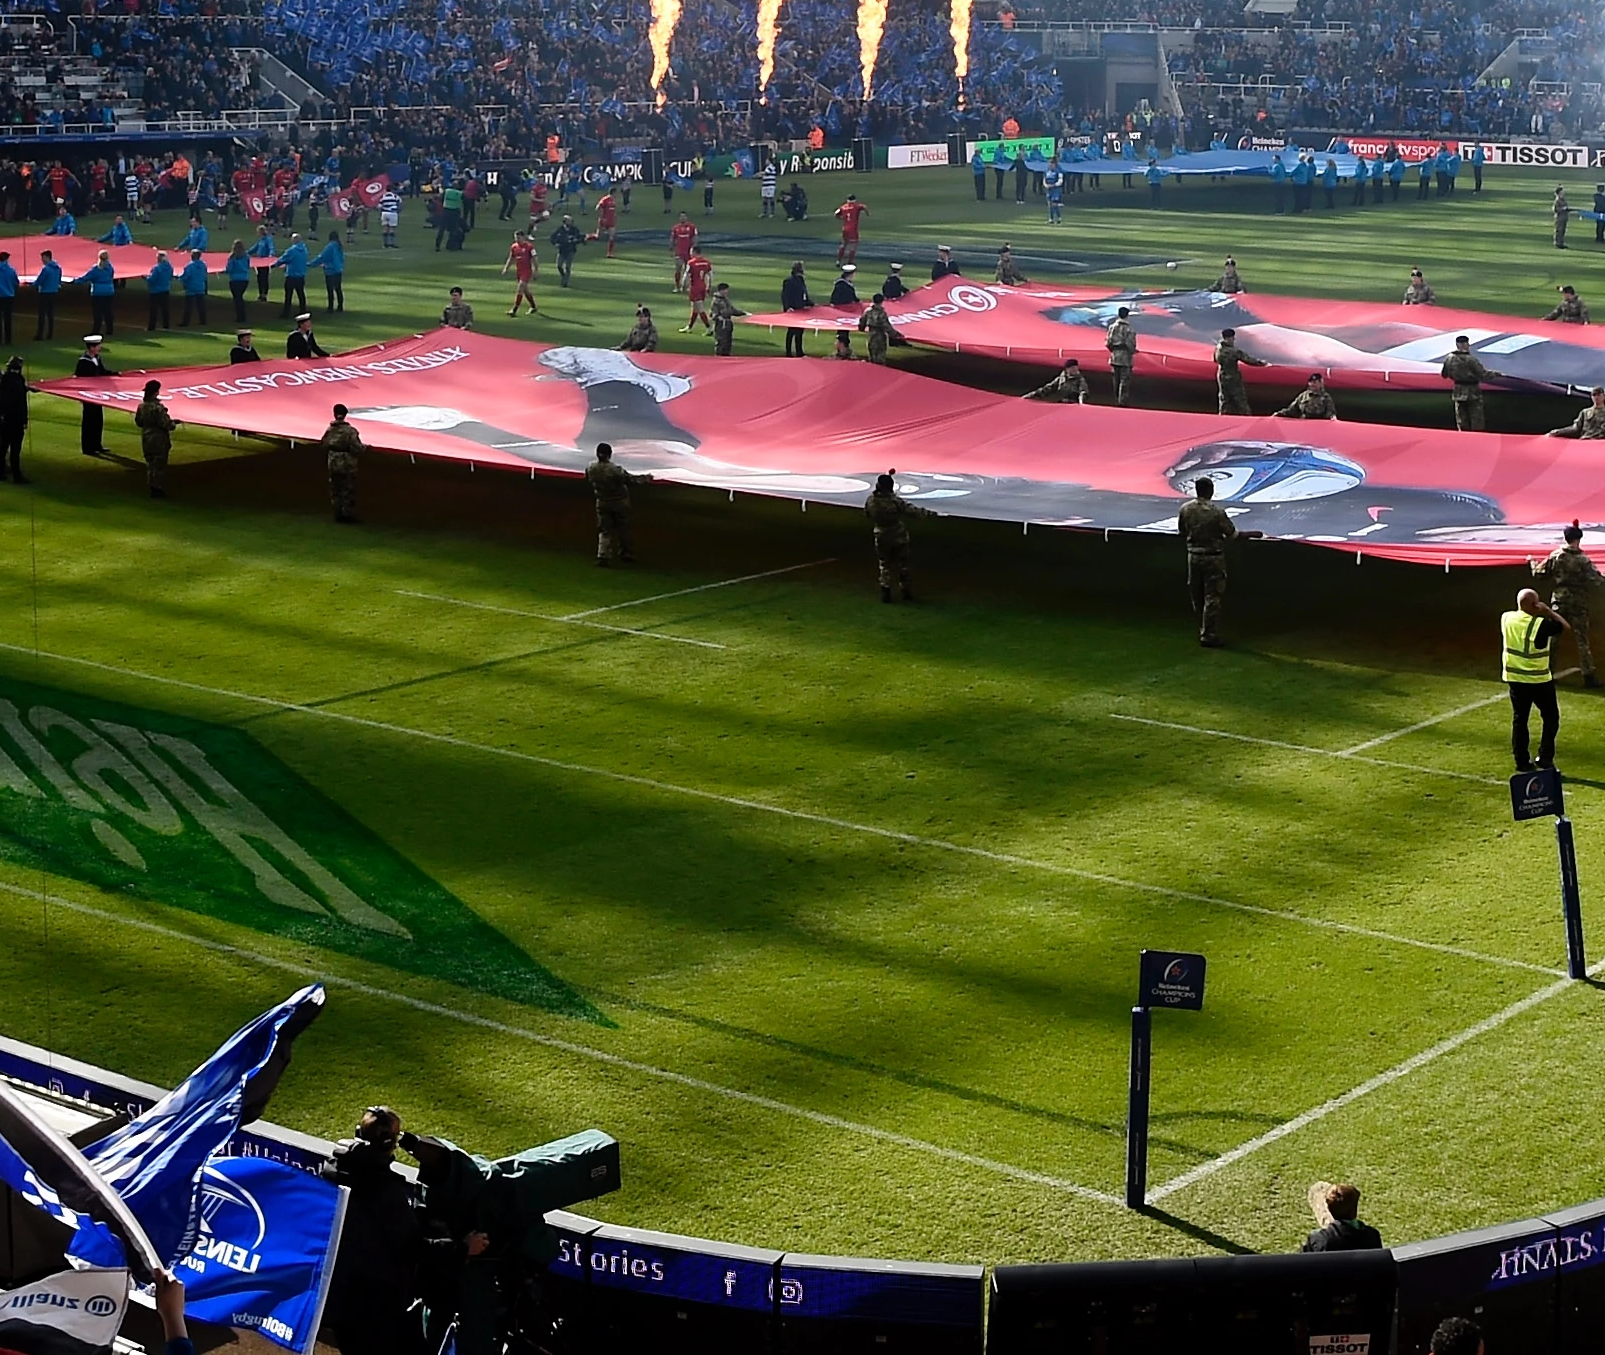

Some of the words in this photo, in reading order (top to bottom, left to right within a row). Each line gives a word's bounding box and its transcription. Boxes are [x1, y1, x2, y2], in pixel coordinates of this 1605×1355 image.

[1495, 147, 1583, 165] TISSOT
[172, 363, 373, 400] NEWCASTLE
[1151, 988, 1196, 999] CHAMPIONS
[558, 1236, 665, 1283] Stories
[1491, 1231, 1598, 1280] FINALS
[1310, 1343, 1369, 1355] TISSOT
